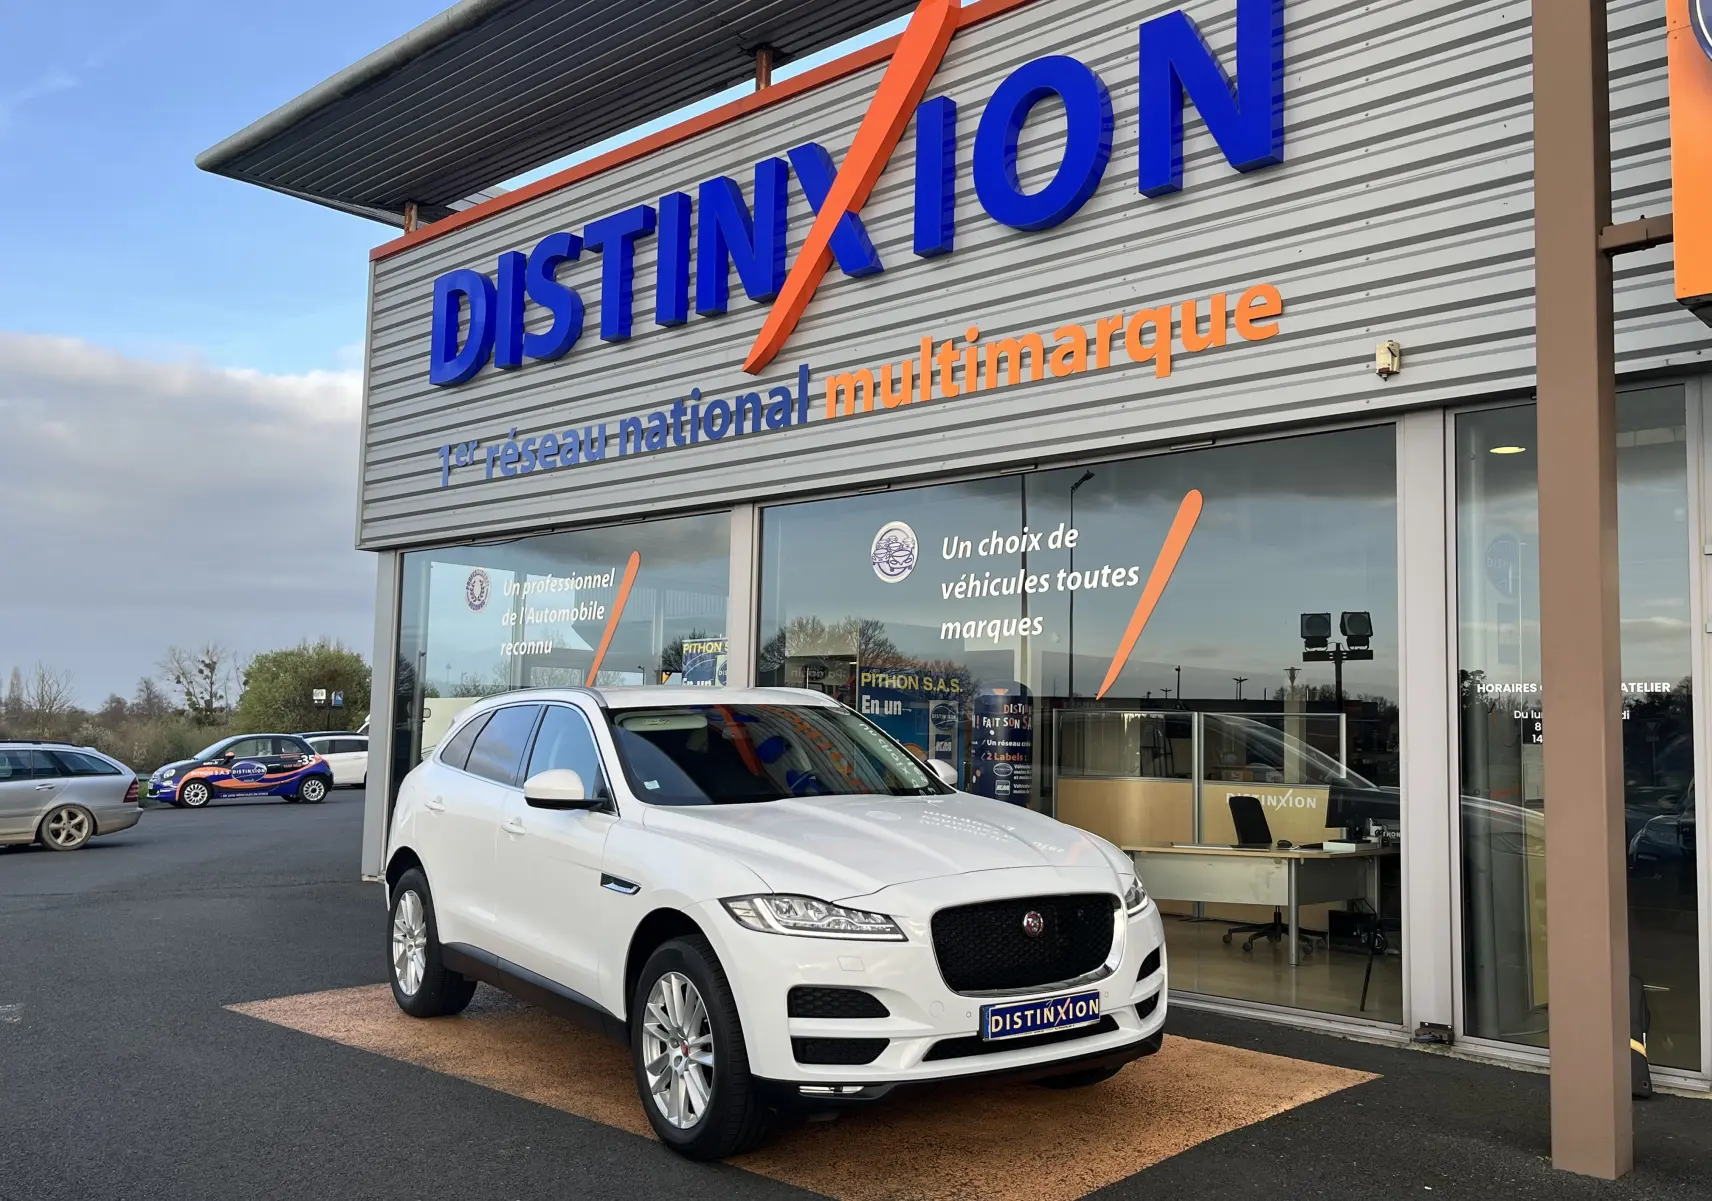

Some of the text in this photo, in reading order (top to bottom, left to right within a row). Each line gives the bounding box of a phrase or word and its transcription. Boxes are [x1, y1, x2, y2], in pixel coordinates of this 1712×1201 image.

[430, 0, 1284, 386] DISTINXION
[438, 283, 1283, 487] 1er réseau national multimarque
[942, 523, 1079, 560] Un choix de
[503, 568, 615, 600] Un professionnel
[941, 564, 1140, 600] véhicules toutes
[502, 601, 605, 626] de l'Automobile
[940, 616, 1044, 644] marques
[500, 639, 553, 656] reconnu
[683, 641, 723, 654] PITHON
[861, 672, 919, 690] PITHON
[923, 676, 963, 693] S.A.S.
[1477, 683, 1537, 693] HORAIRES
[861, 694, 902, 715] En un
[1514, 710, 1528, 719] Du
[982, 716, 1000, 728] FAIT
[1003, 716, 1020, 729] SON
[991, 997, 1099, 1033] DISTINXION
